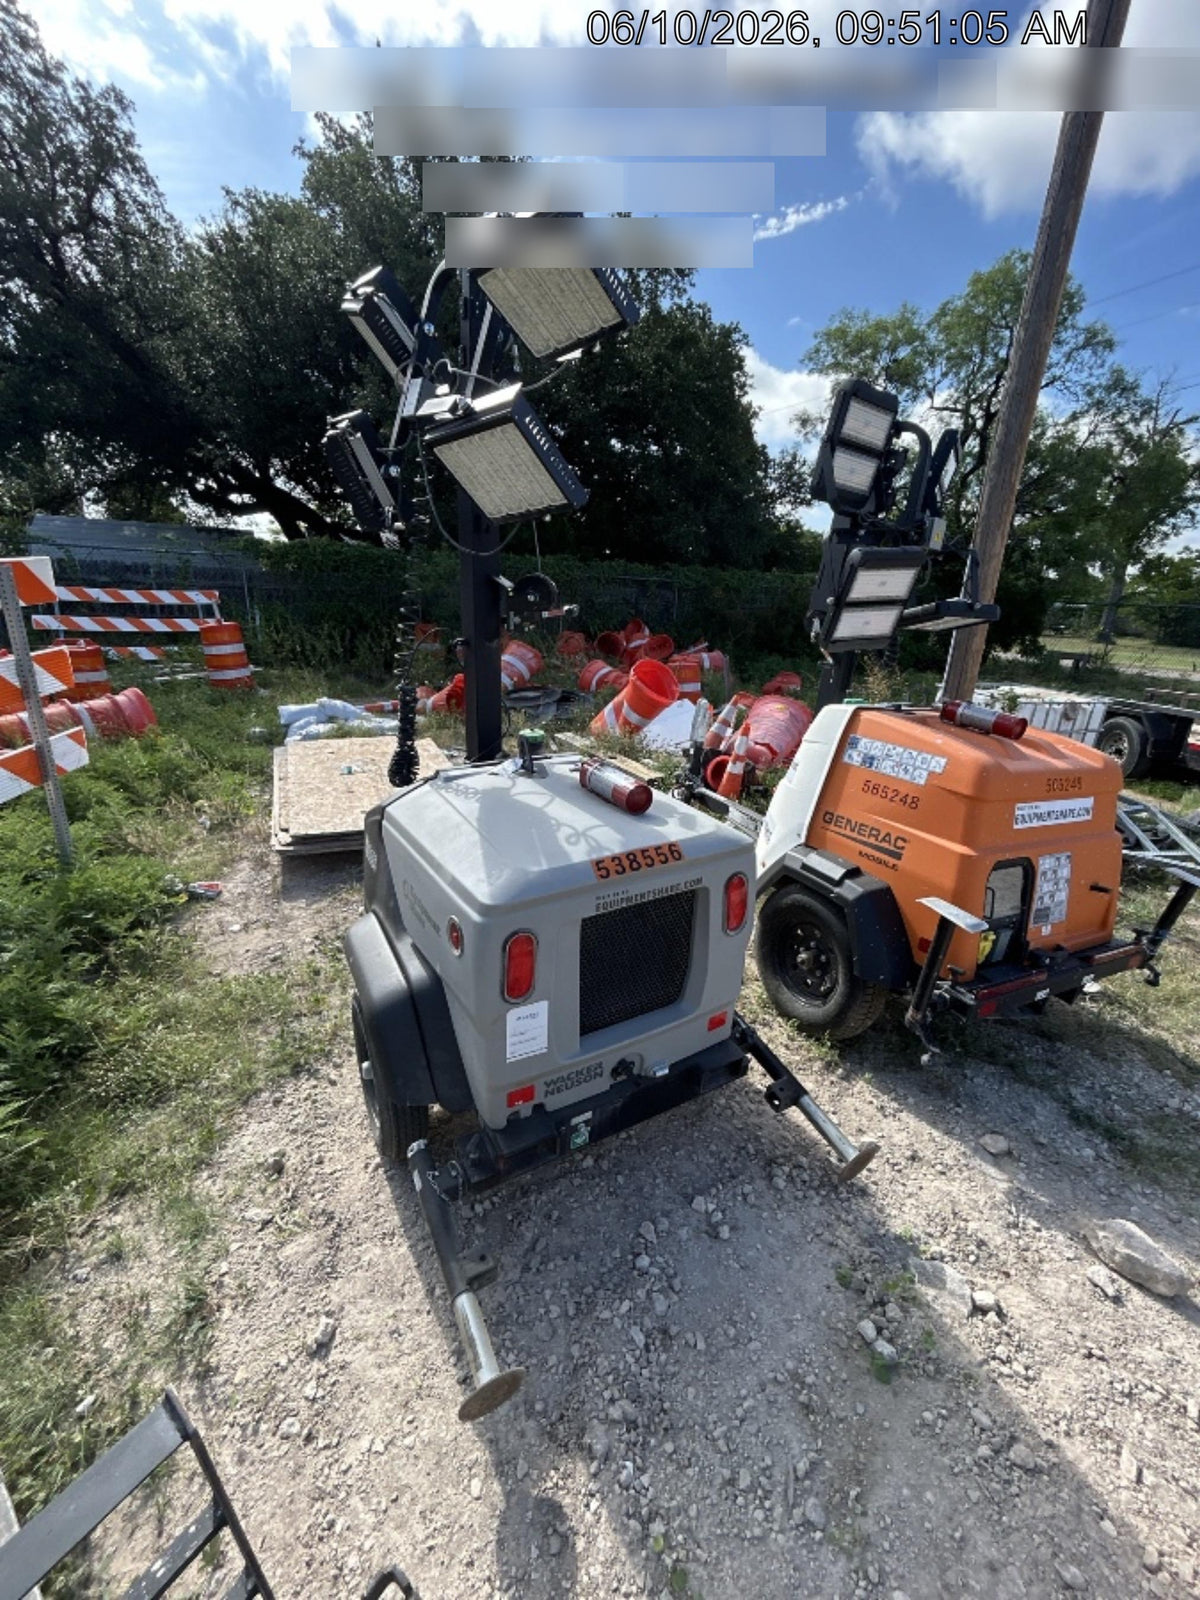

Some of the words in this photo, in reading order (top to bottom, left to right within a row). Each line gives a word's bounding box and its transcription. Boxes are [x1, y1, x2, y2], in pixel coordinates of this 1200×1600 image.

[861, 779, 920, 810] 565248
[822, 810, 908, 850] GENERAC
[594, 842, 683, 880] 538556
[543, 1061, 604, 1089] WACKER
[543, 1069, 604, 1098] NEUSON
